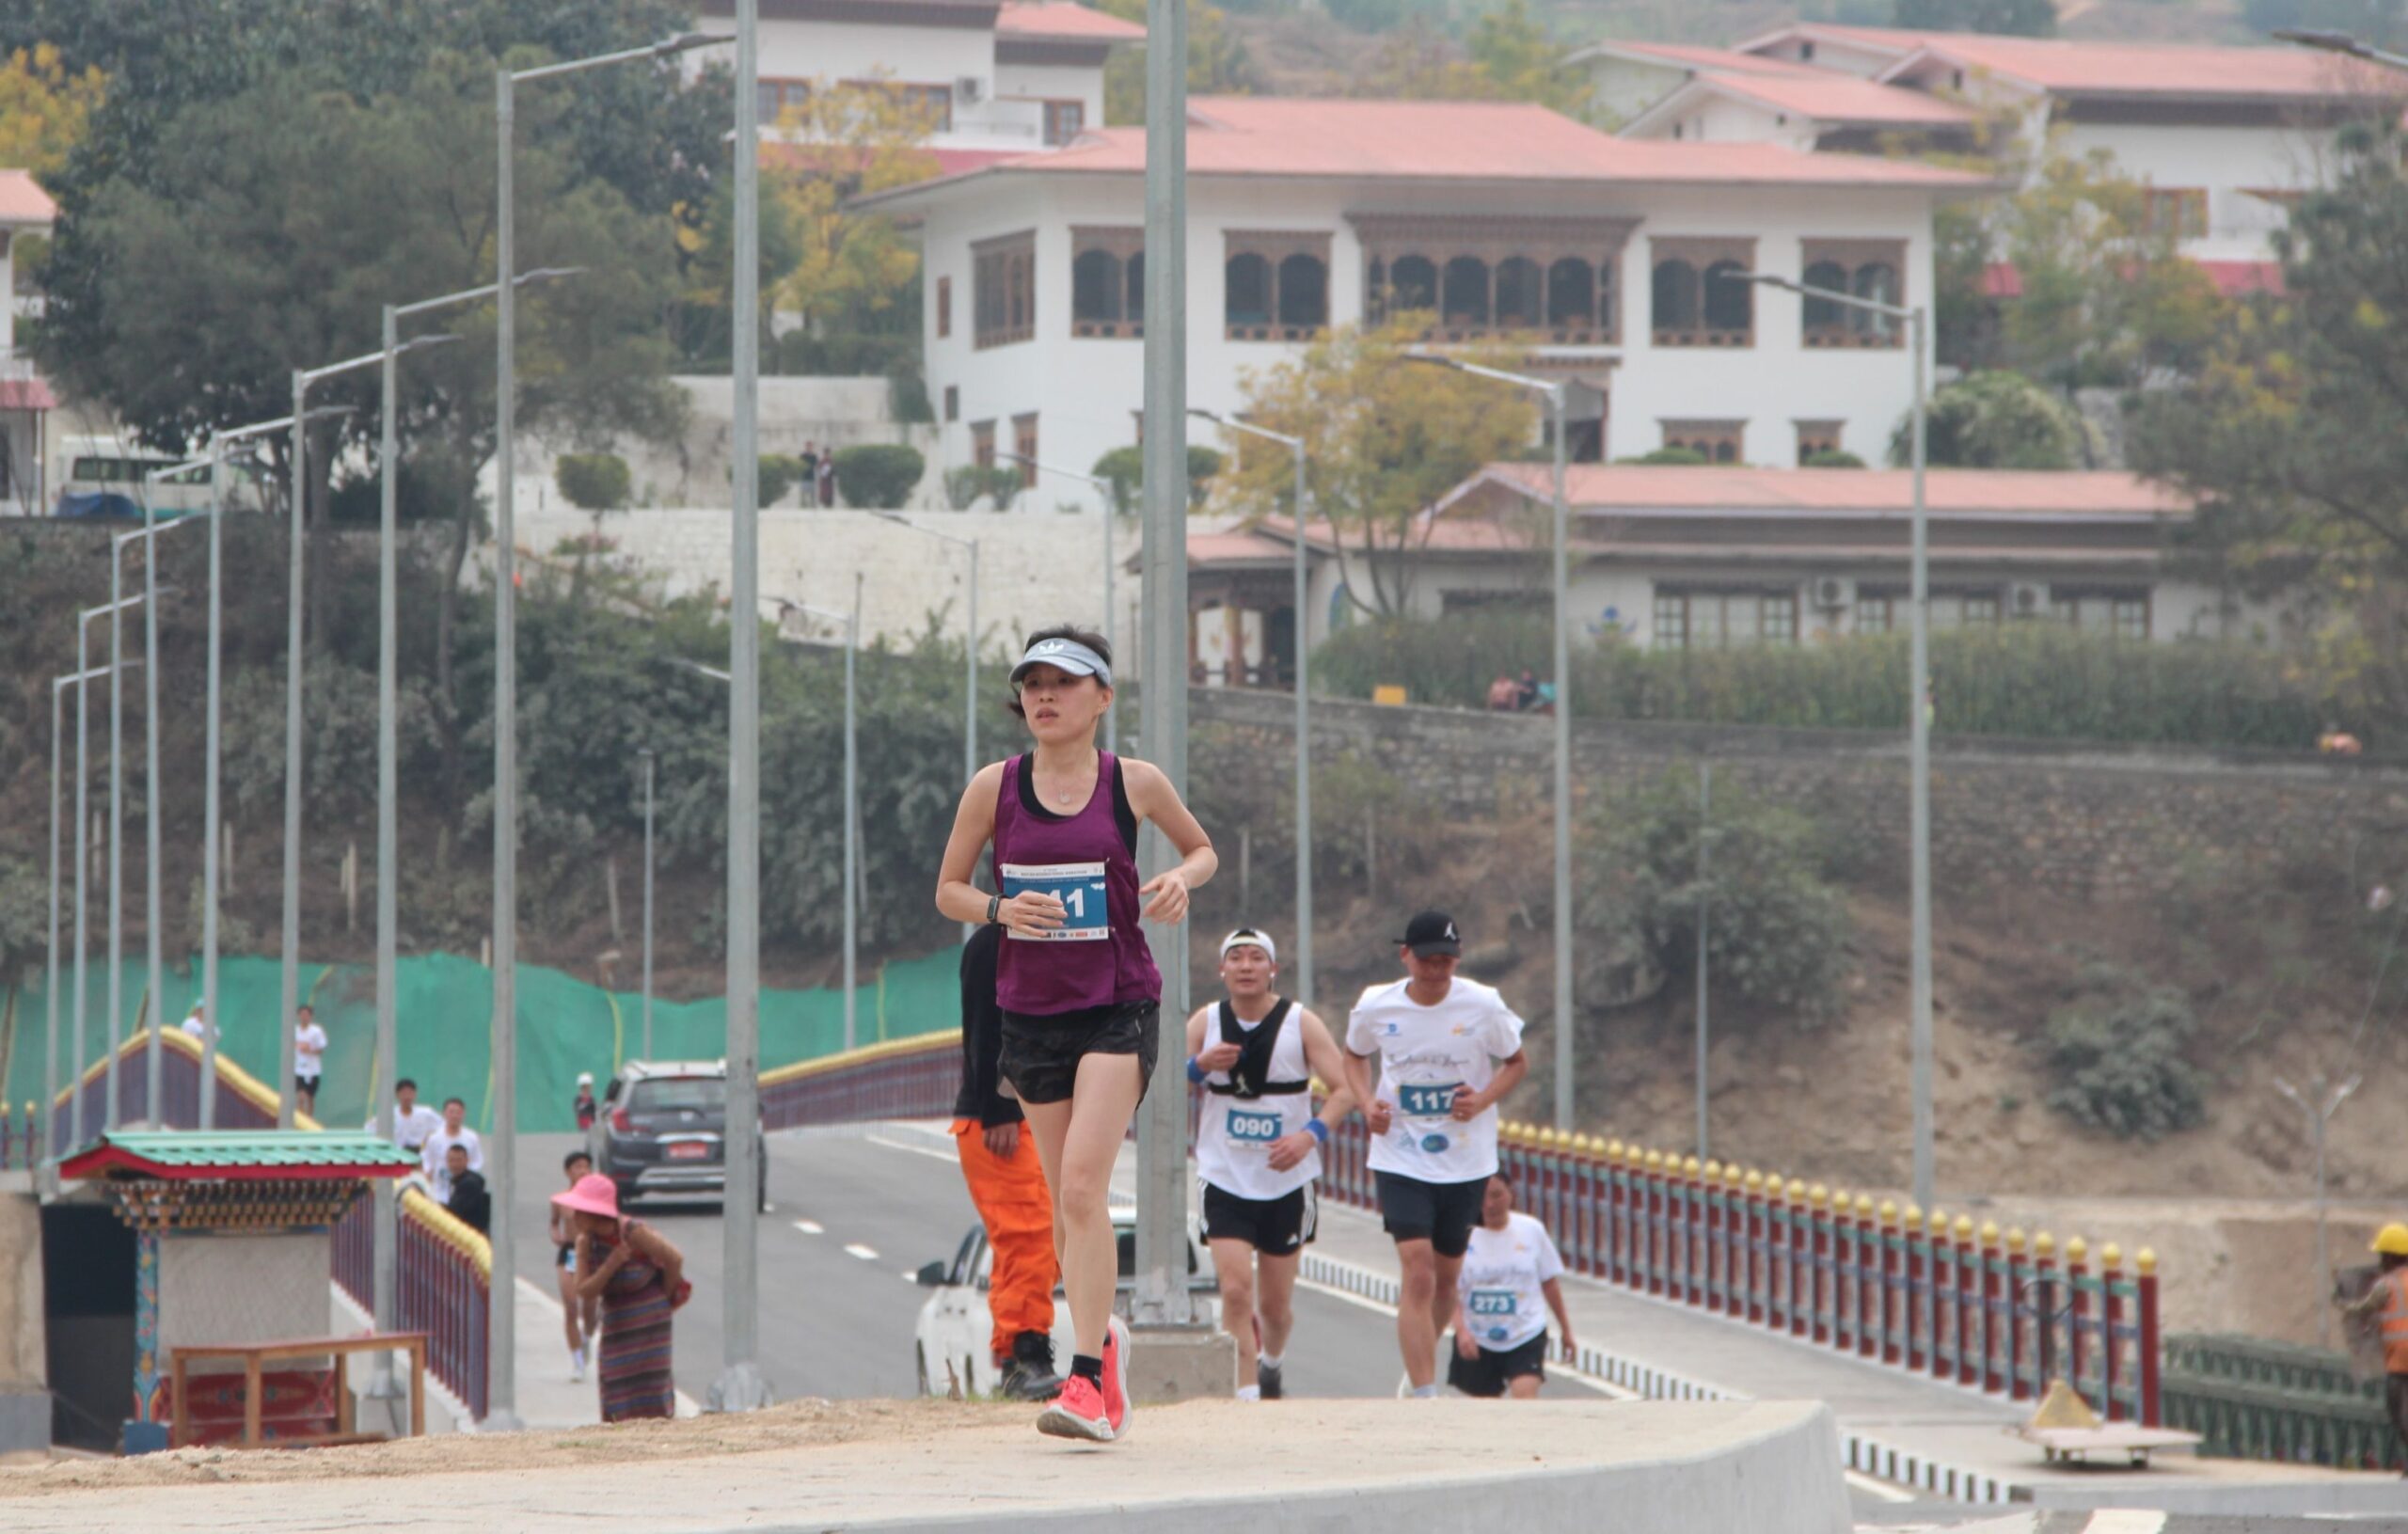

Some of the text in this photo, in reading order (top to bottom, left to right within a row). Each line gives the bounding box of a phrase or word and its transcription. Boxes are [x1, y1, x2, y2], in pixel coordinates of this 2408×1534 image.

[1411, 1091, 1456, 1111] 117
[1233, 1113, 1274, 1137] 090
[1474, 1295, 1510, 1312] 273
